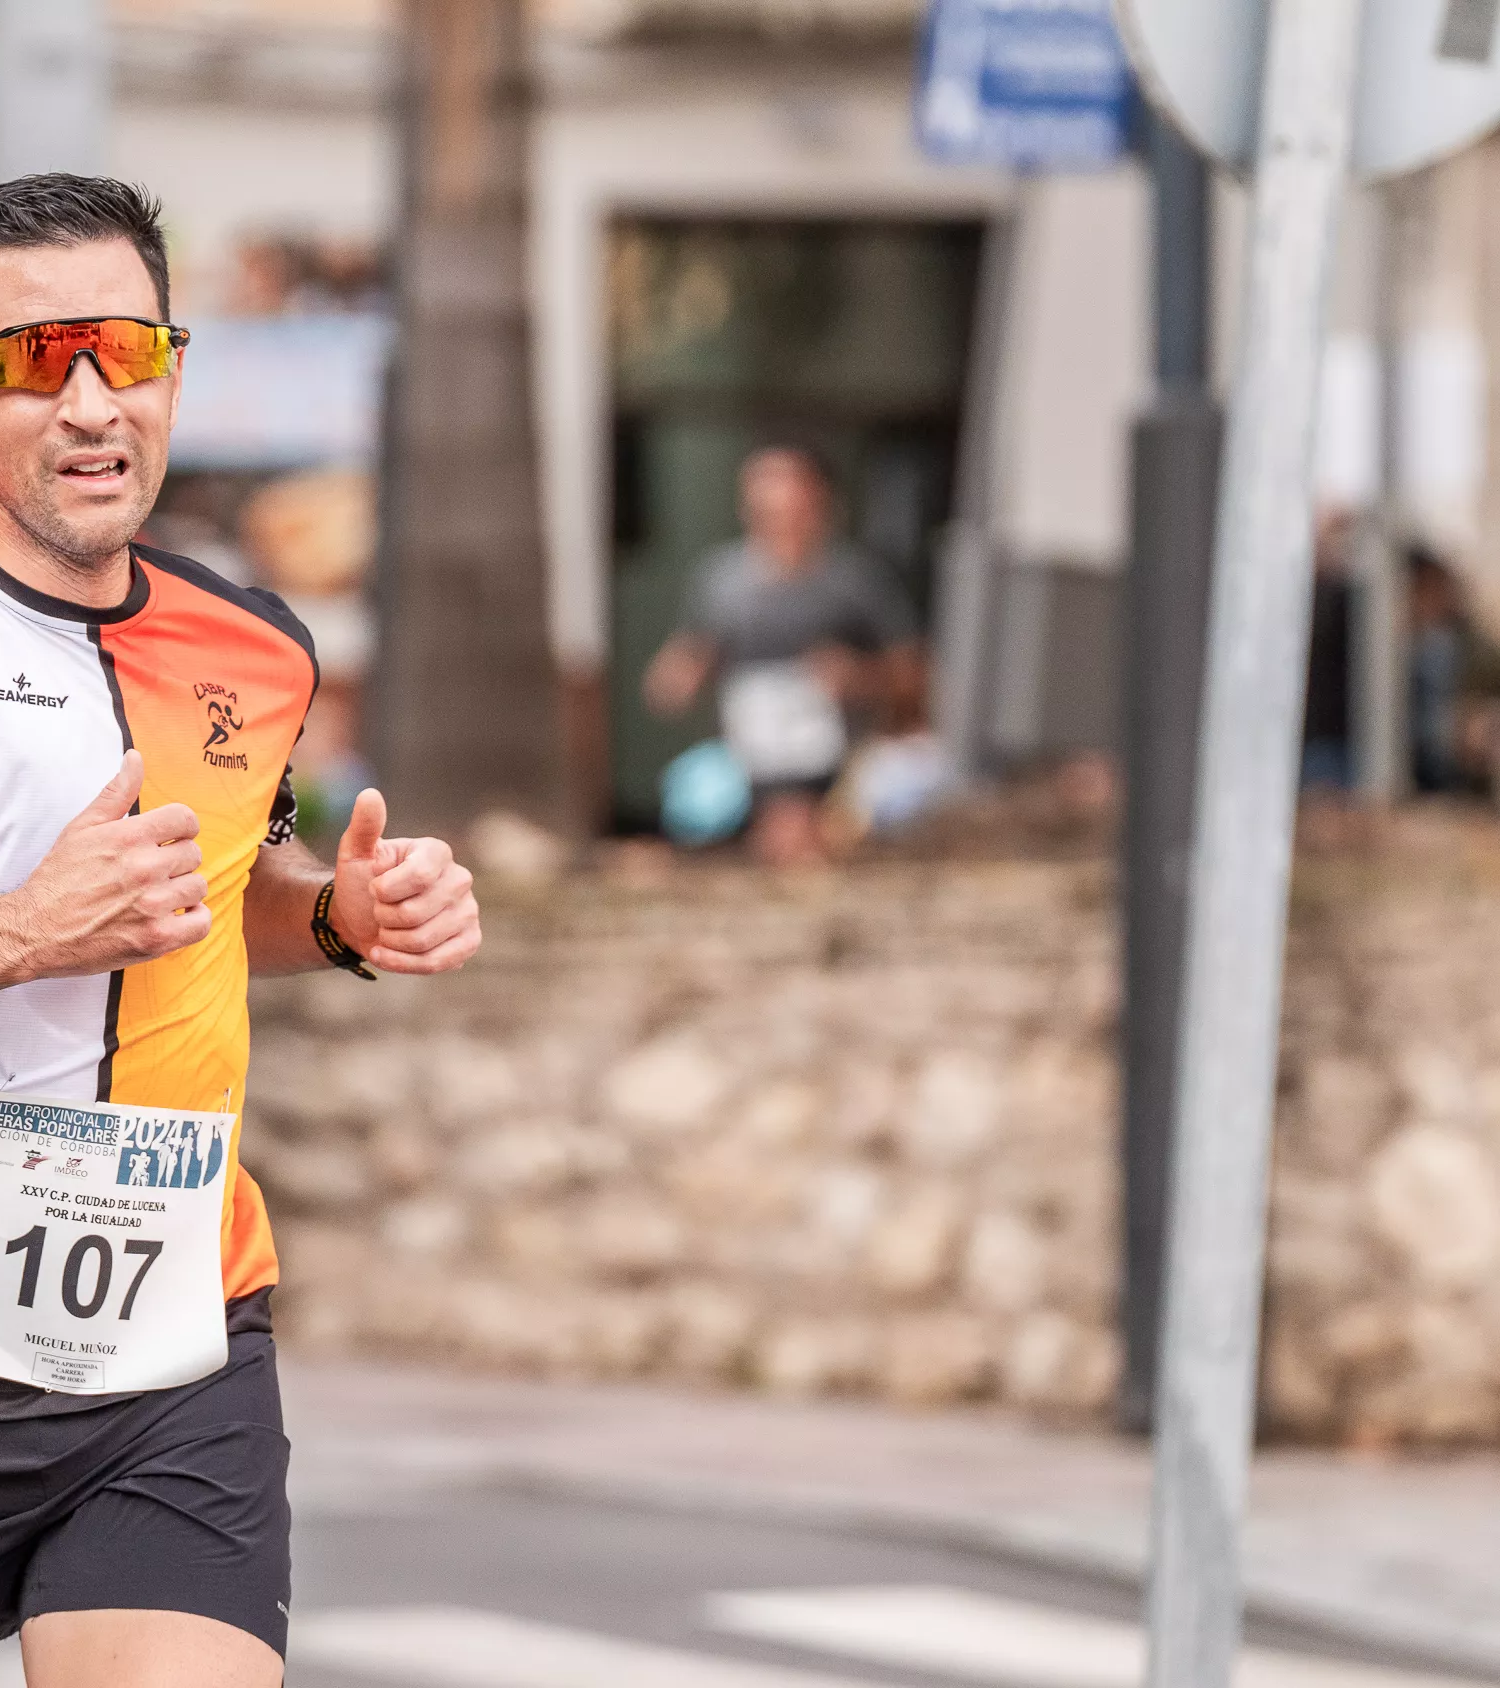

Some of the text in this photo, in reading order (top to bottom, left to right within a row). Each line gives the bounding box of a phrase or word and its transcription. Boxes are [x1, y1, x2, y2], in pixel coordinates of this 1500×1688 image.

[203, 750, 248, 771] running
[24, 1105, 101, 1128] PROVINCIAL
[104, 1116, 120, 1130] DE
[37, 1119, 119, 1144] POPULARES
[121, 1115, 183, 1151] 2024
[37, 1135, 52, 1148] DE
[60, 1139, 116, 1158] CÓRDOBA
[54, 1166, 88, 1178] IMDECO
[20, 1184, 167, 1212] XXV C.P. CIUDAD DE LUCENA
[45, 1206, 142, 1228] POR LA IGUALDAD
[5, 1225, 164, 1320] 107
[24, 1333, 118, 1355] MIGUEL MUÑOZ
[41, 1357, 98, 1370] HORA APROXIMADA
[55, 1367, 85, 1376] CARRERA
[67, 1376, 86, 1384] HORAS
